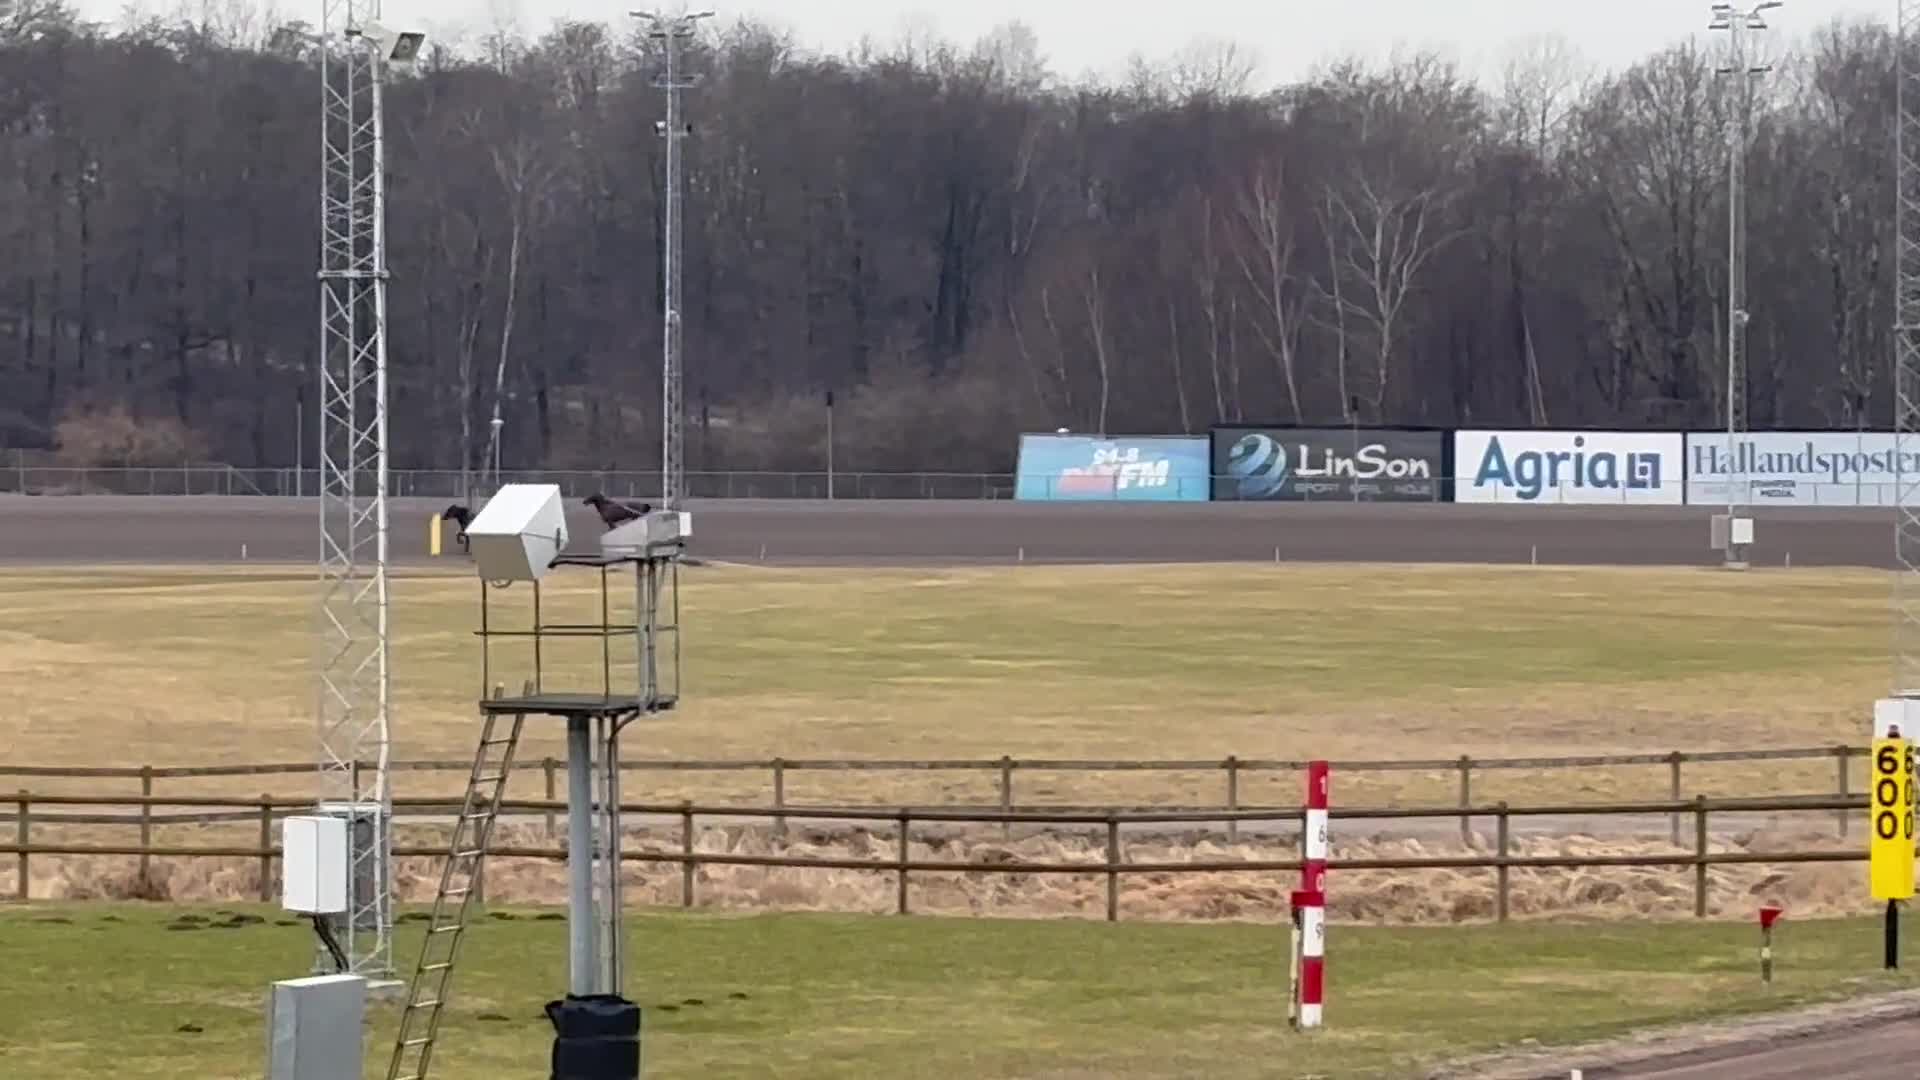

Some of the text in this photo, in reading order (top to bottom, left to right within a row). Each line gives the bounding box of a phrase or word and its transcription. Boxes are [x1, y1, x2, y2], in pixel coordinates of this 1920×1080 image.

[1117, 460, 1169, 490] FM
[1294, 444, 1430, 479] LinSon
[1473, 435, 1618, 500] Agria
[1876, 745, 1899, 841] 600
